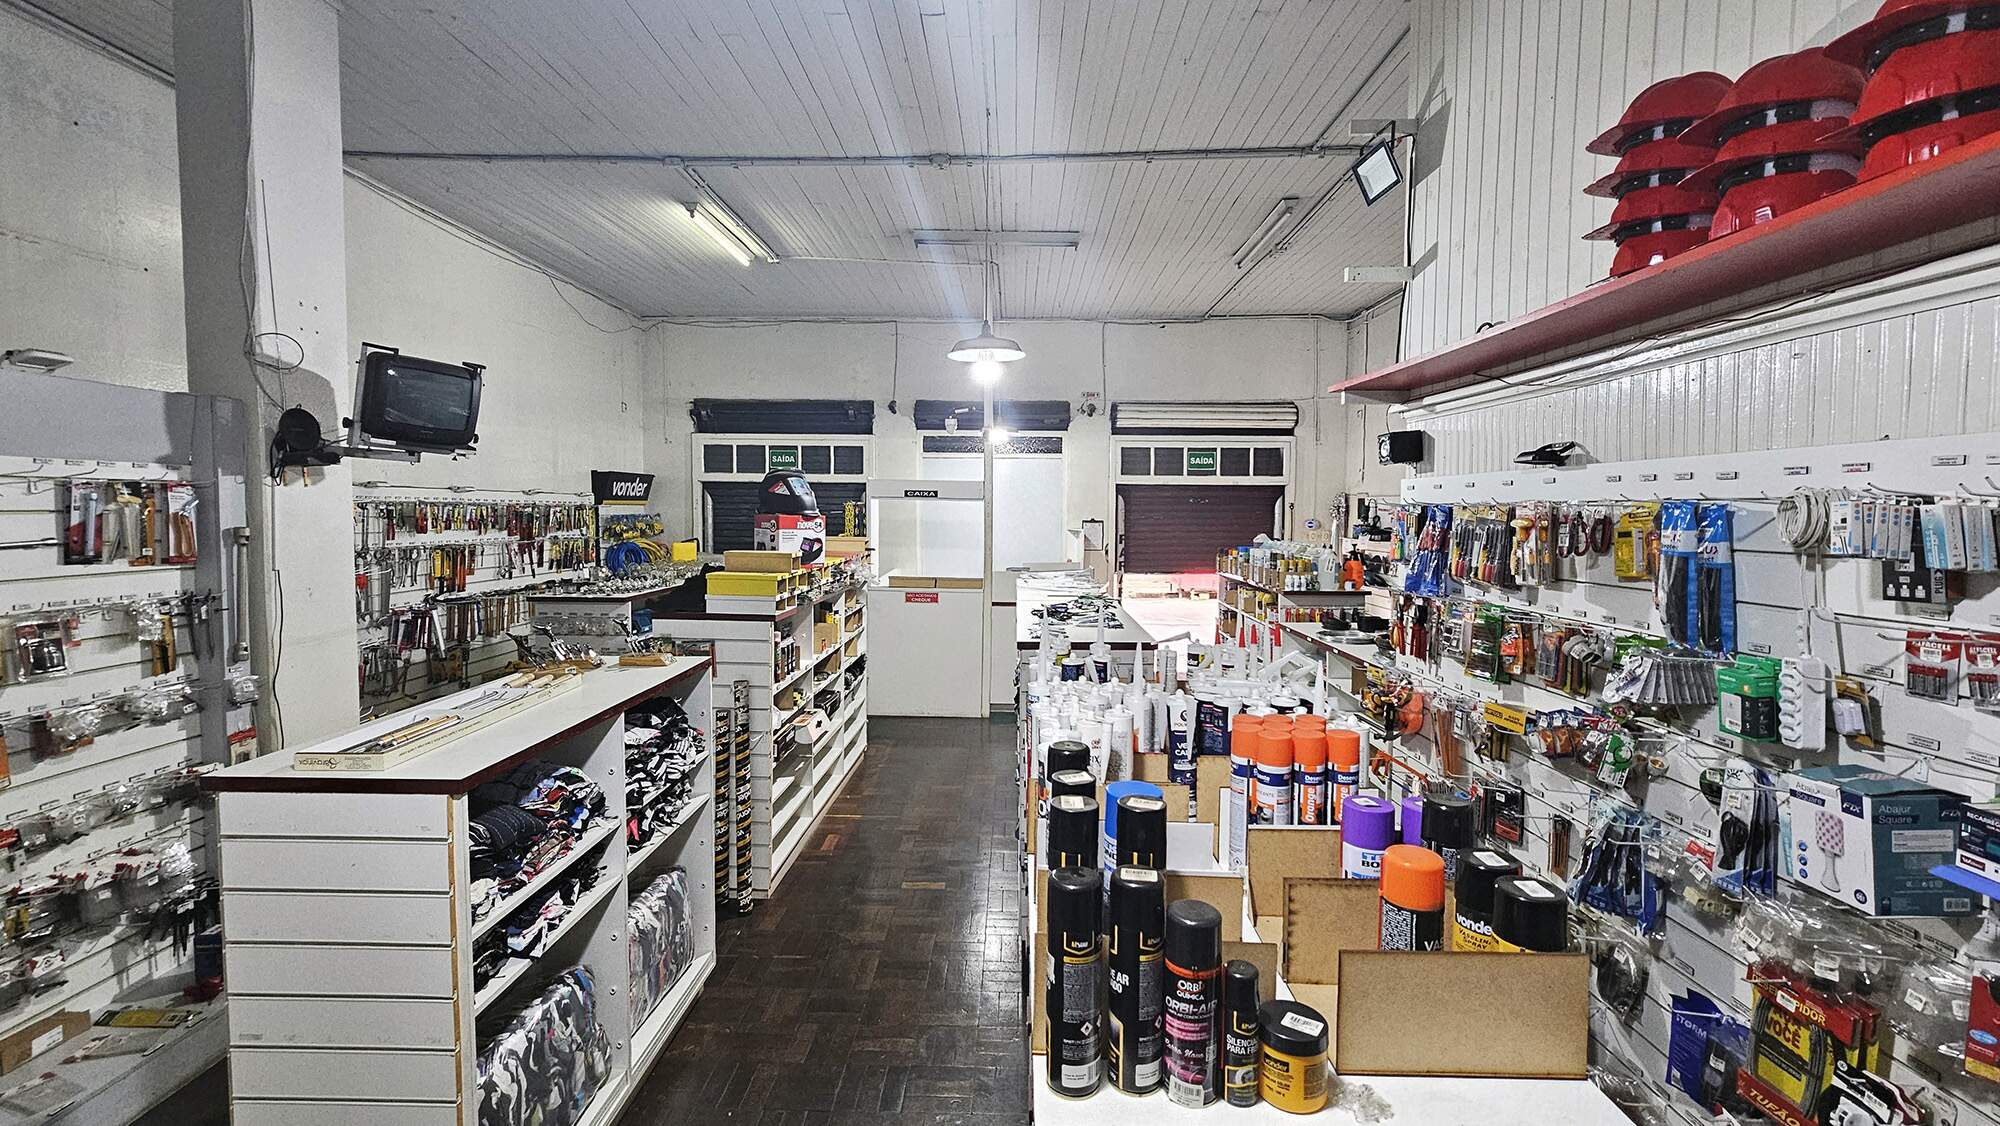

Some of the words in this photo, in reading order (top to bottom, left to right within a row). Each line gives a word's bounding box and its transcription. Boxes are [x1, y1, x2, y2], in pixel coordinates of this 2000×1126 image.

[771, 454, 796, 463] SAÍDA
[1190, 456, 1214, 465] SAÍDA
[612, 477, 648, 497] vonder
[1879, 804, 1912, 816] Abajur
[1879, 815, 1912, 825] Square
[1361, 860, 1380, 868] BO
[1115, 971, 1130, 987] AR
[1226, 1043, 1246, 1055] PARA
[1264, 1057, 1288, 1072] vonder
[1749, 1087, 1801, 1126] TUFÃO
